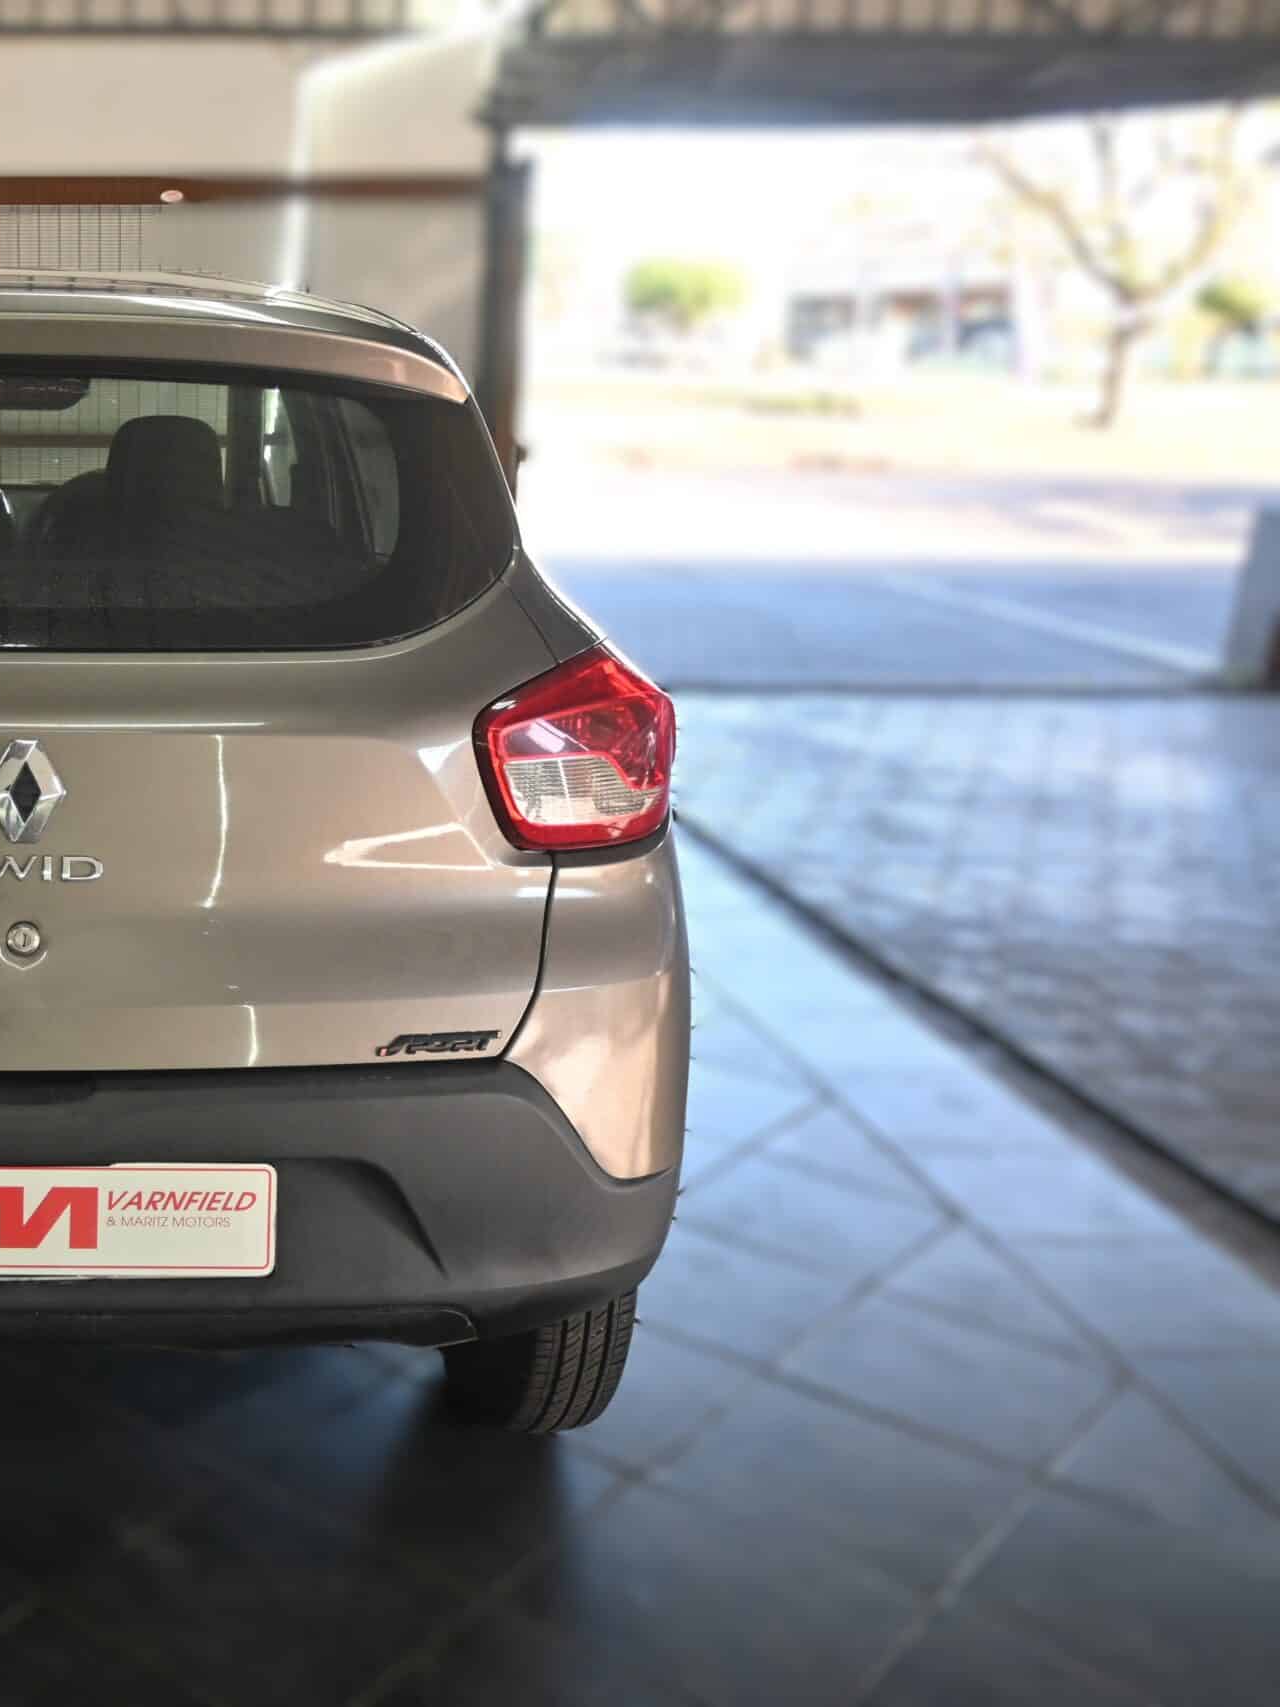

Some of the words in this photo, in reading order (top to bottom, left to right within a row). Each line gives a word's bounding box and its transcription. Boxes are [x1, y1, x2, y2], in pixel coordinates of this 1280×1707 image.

[106, 1191, 256, 1211] VARNFIELD
[107, 1217, 117, 1228] &
[121, 1216, 169, 1228] MARITZ
[172, 1215, 231, 1228] MOTORS
